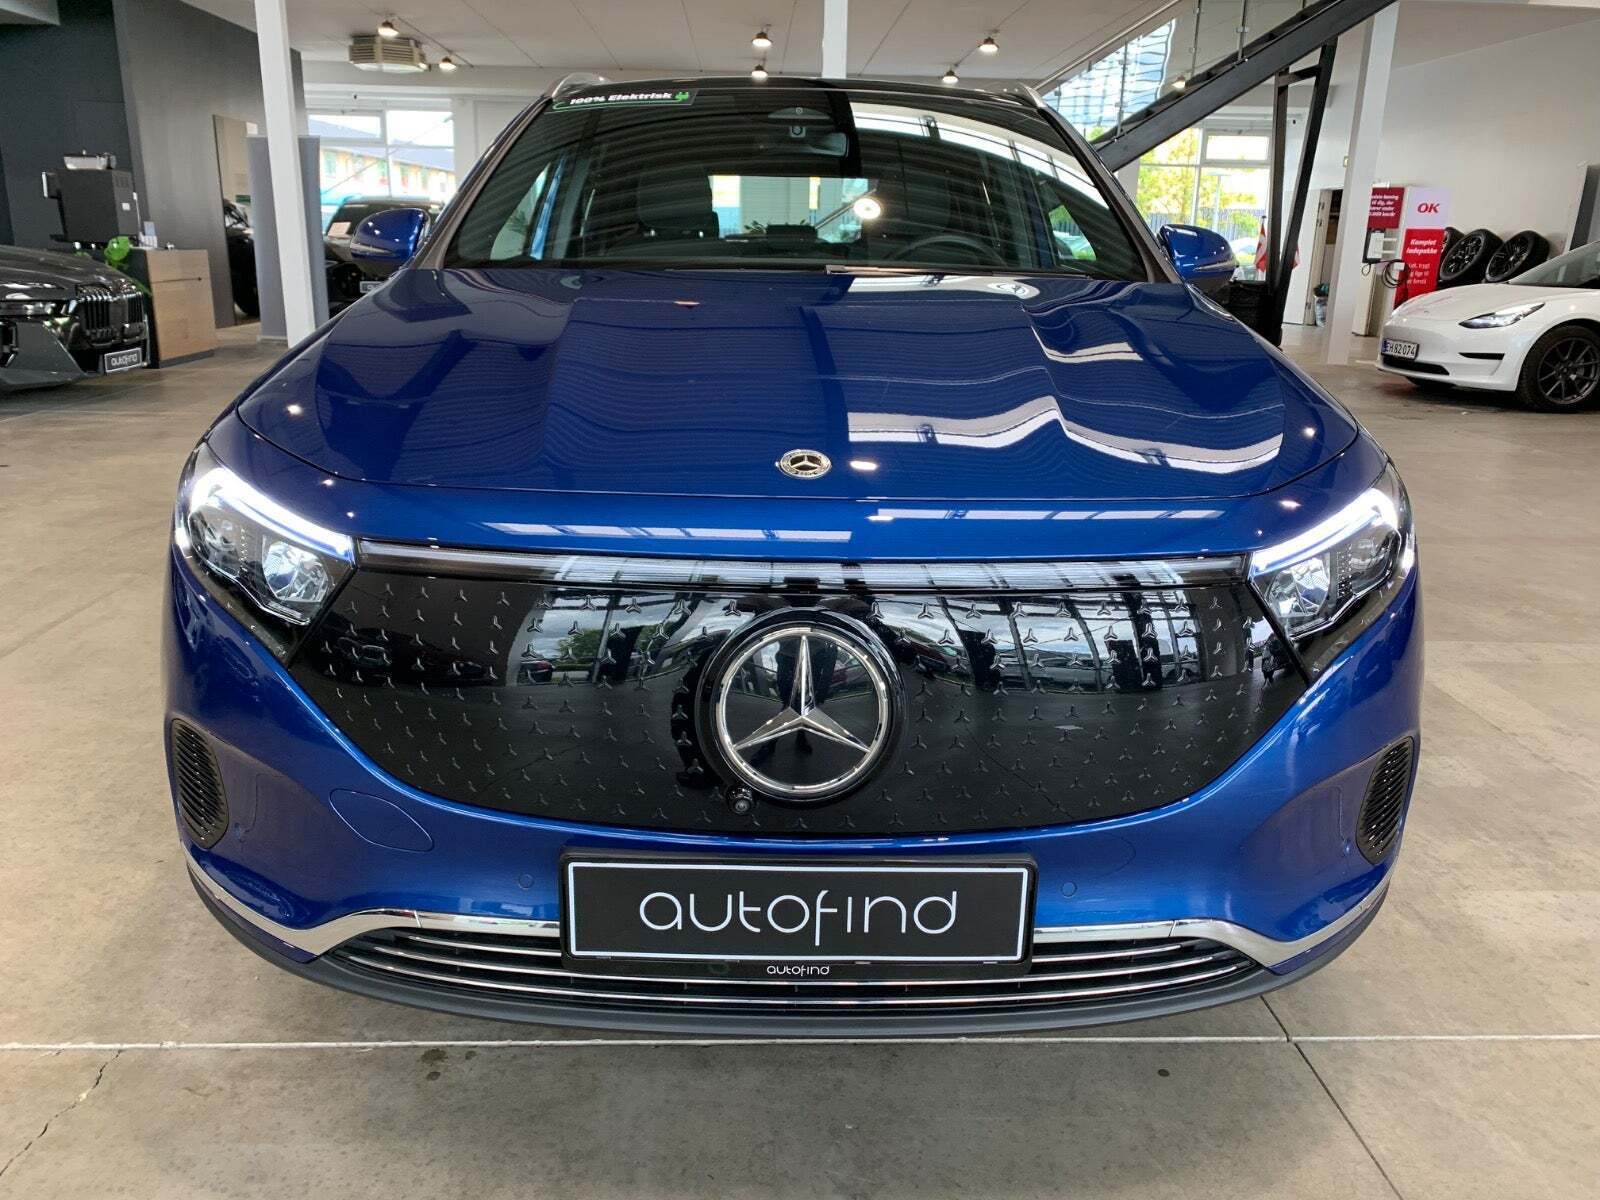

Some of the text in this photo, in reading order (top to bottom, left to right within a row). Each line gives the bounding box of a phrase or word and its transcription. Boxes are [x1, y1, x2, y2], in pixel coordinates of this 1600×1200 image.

[570, 92, 672, 105] 100% Elektrisk
[1417, 203, 1440, 213] OK
[639, 890, 957, 946] autofind
[766, 965, 830, 977] autofind
